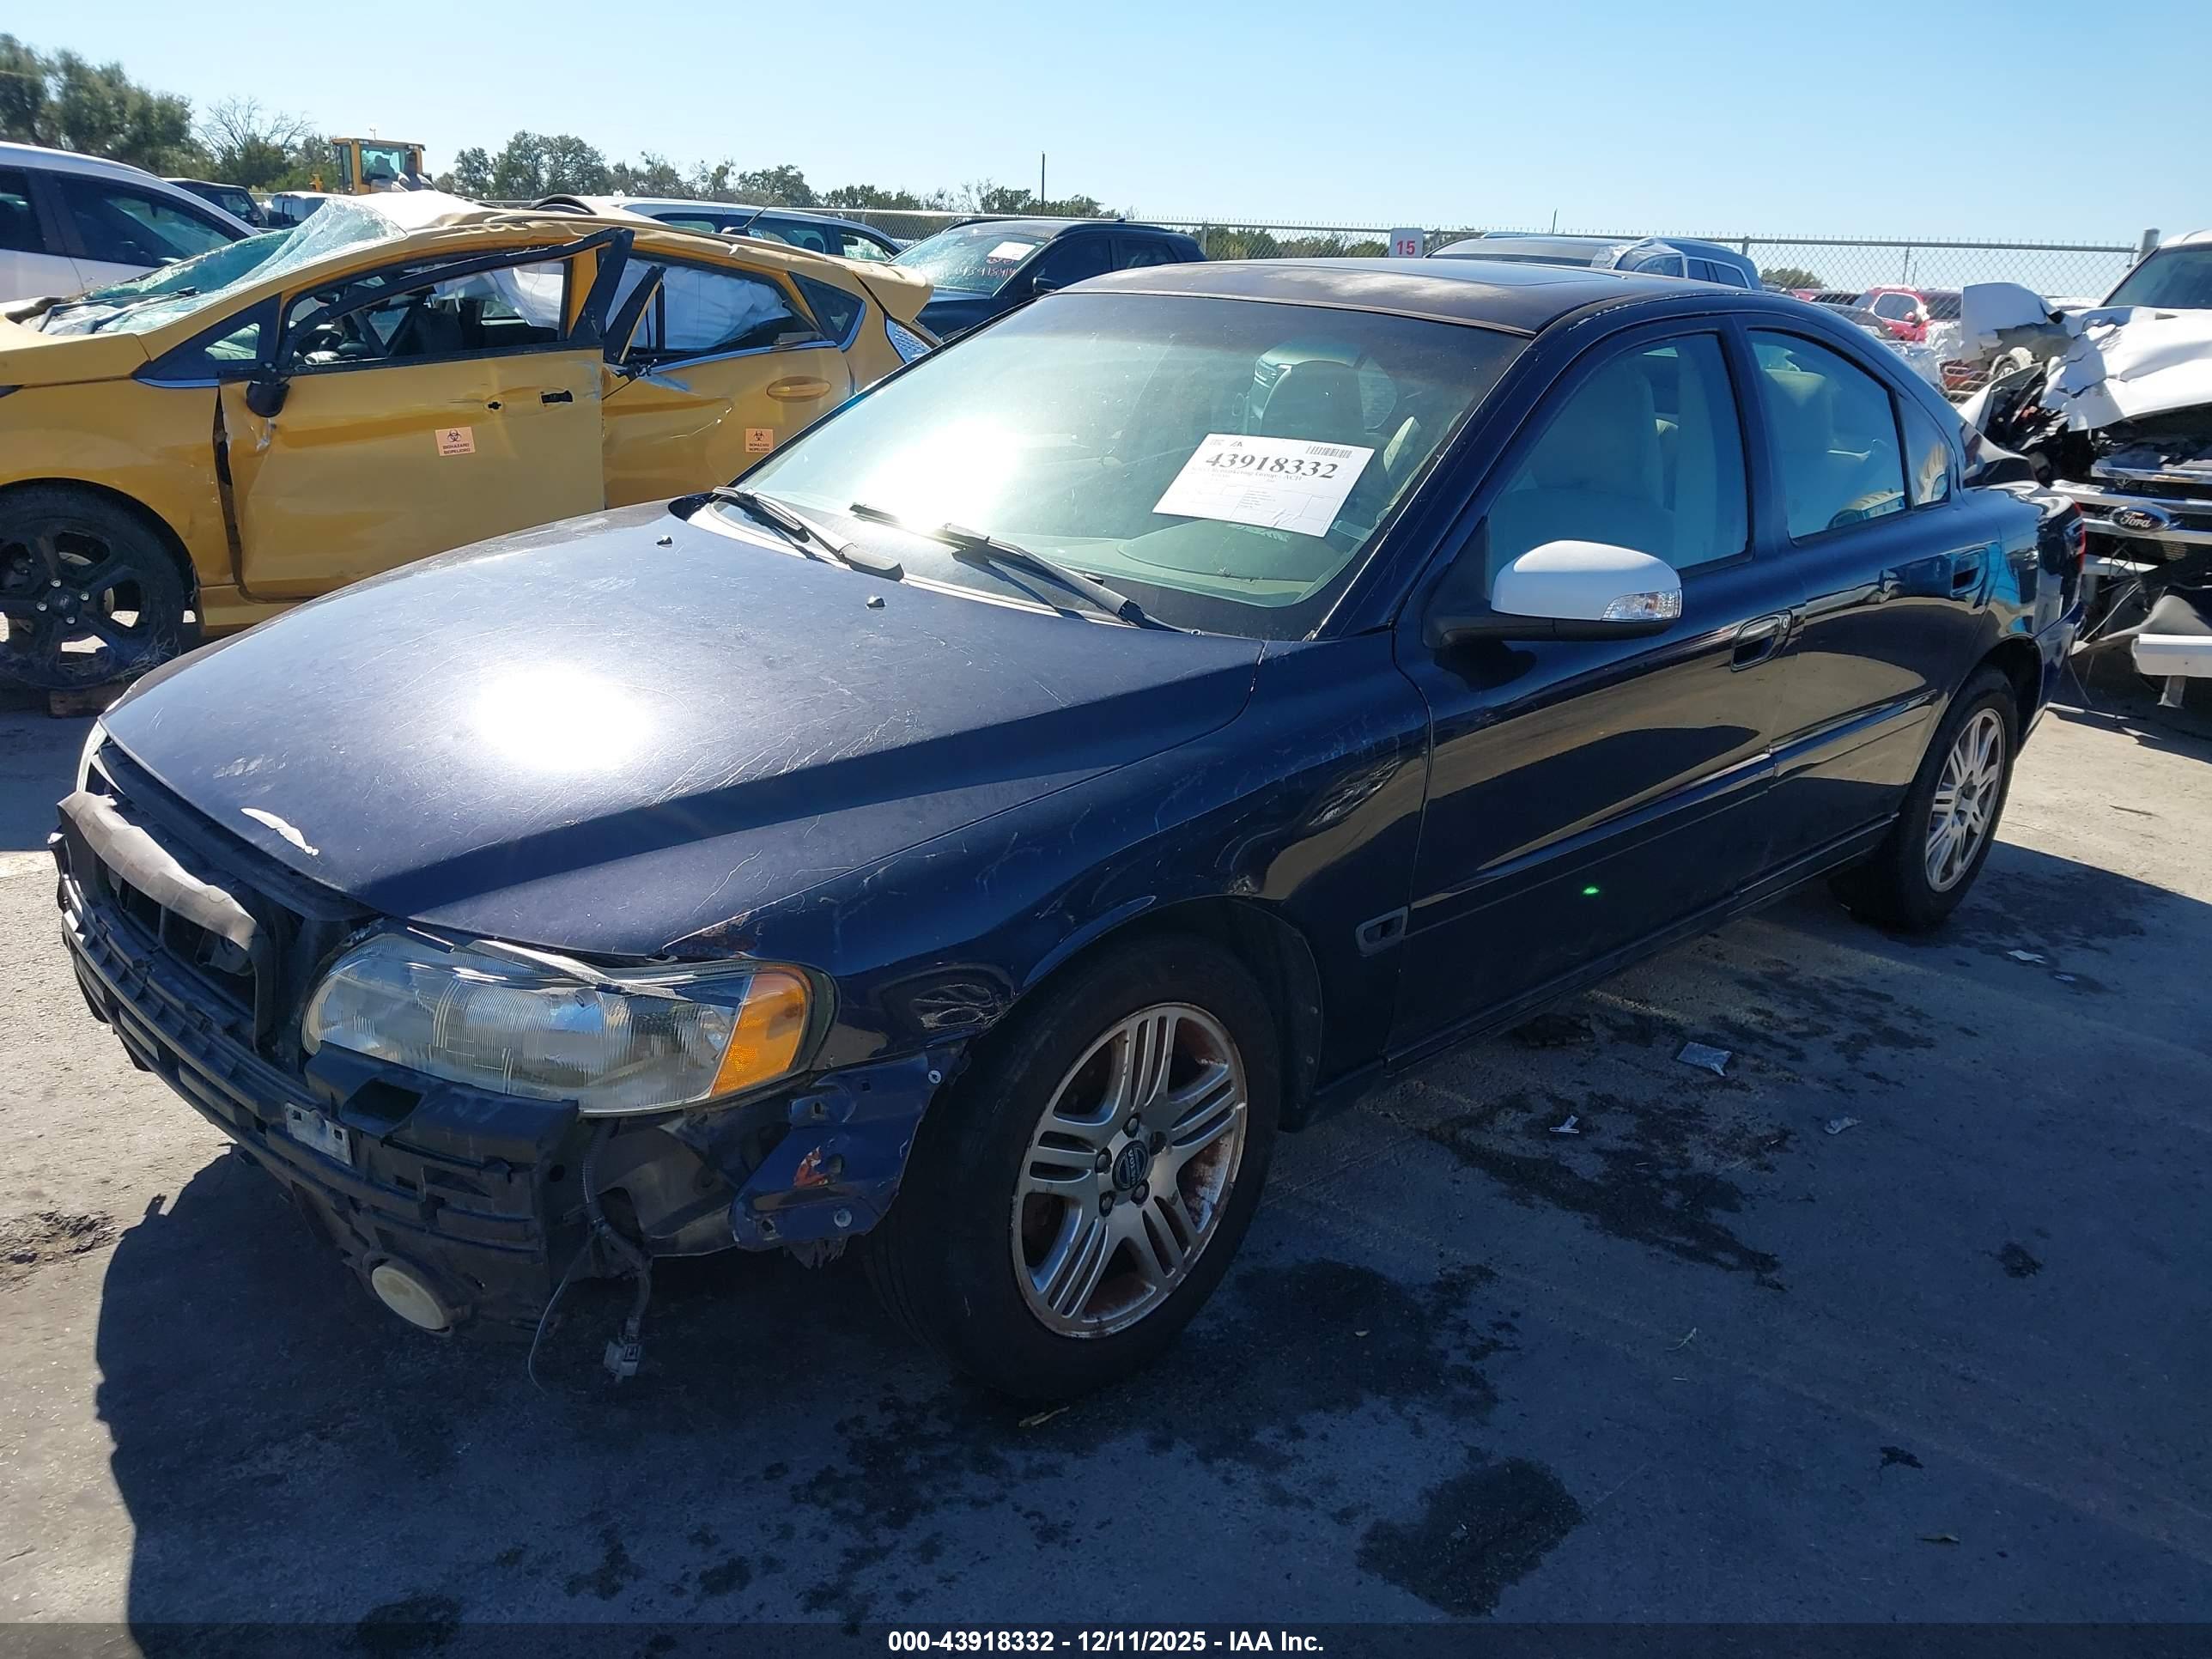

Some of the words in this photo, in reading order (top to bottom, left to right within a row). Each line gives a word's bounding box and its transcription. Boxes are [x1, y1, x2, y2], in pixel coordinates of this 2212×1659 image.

[1396, 240, 1416, 256] 15
[1205, 453, 1340, 479] 43918332
[2119, 511, 2153, 529] Ford
